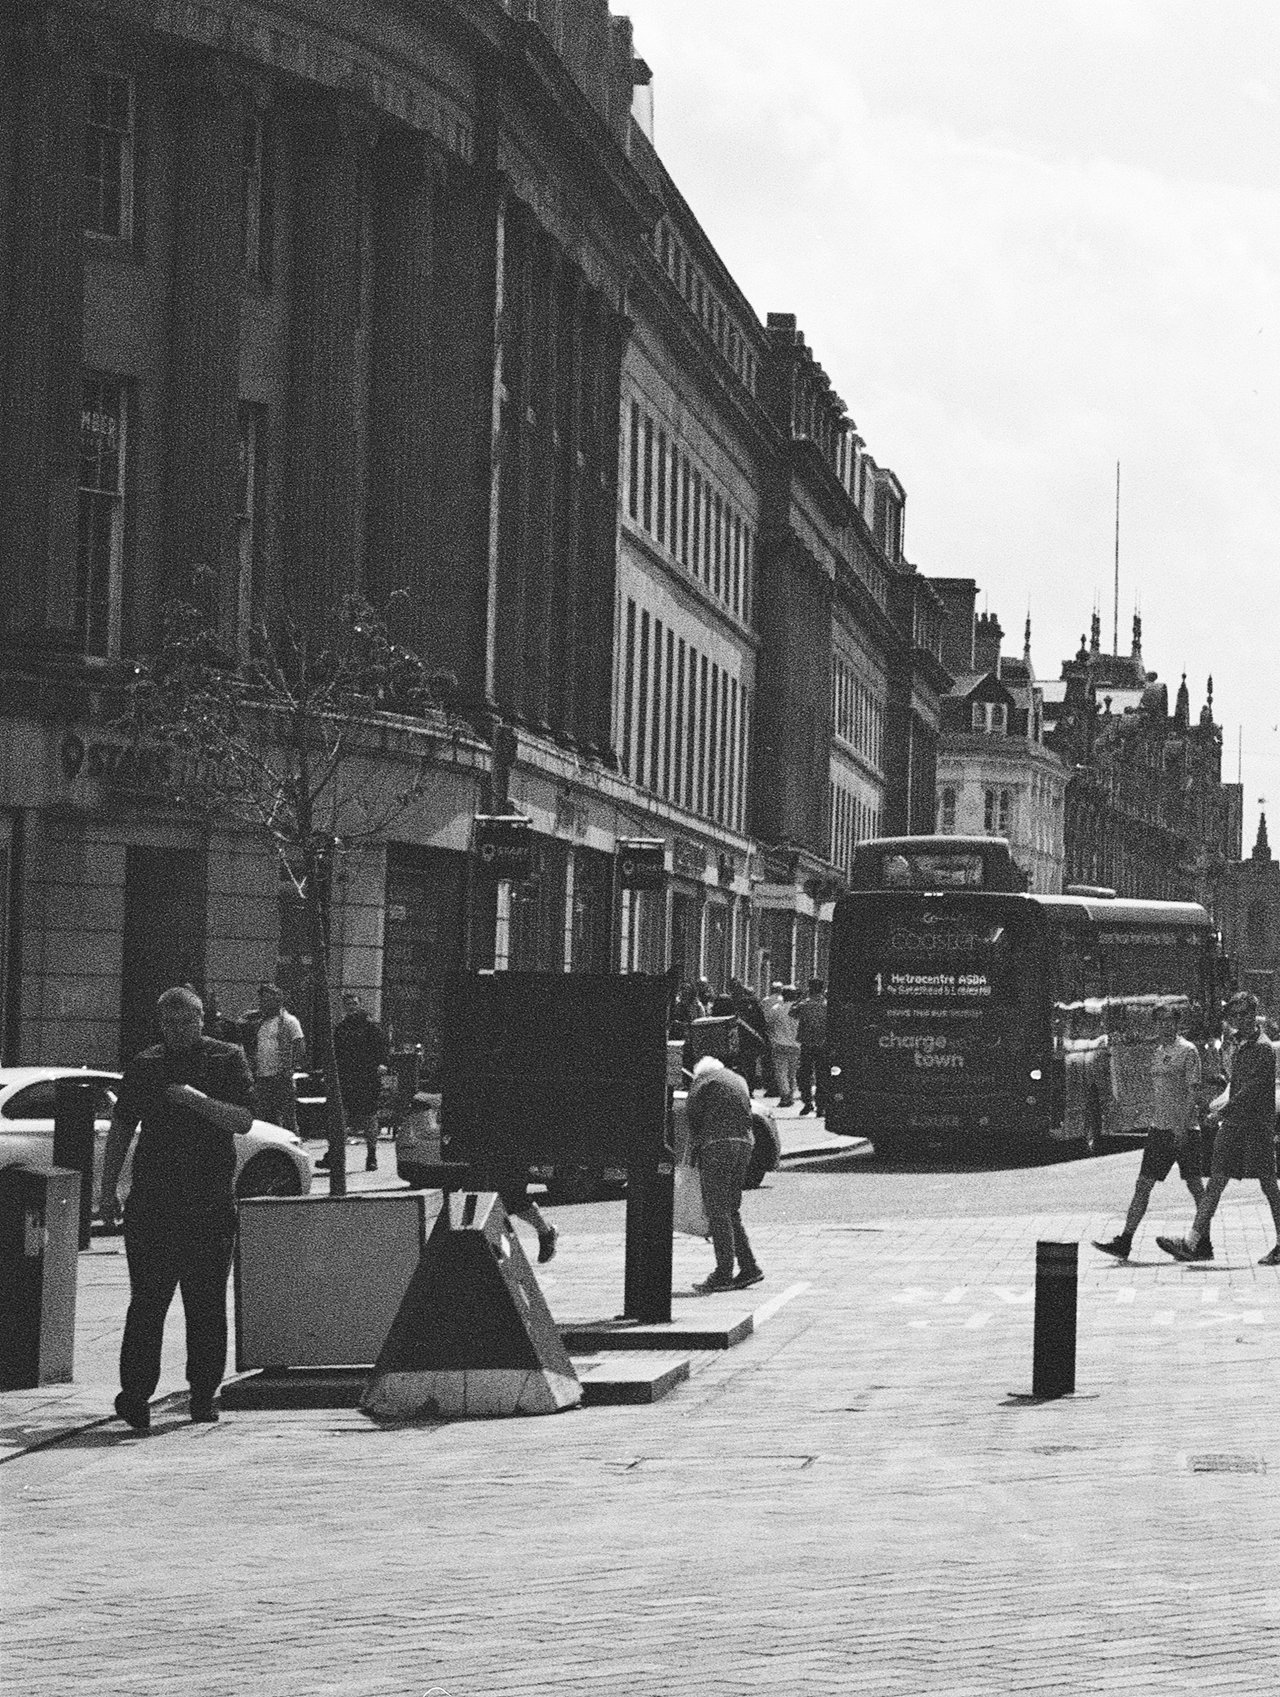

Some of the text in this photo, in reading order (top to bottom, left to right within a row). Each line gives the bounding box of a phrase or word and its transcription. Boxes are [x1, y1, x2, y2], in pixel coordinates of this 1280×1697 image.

[874, 972, 883, 996] 1
[890, 973, 987, 986] Metrocentre ASDA
[879, 1031, 948, 1054] charge
[913, 1049, 965, 1068] town
